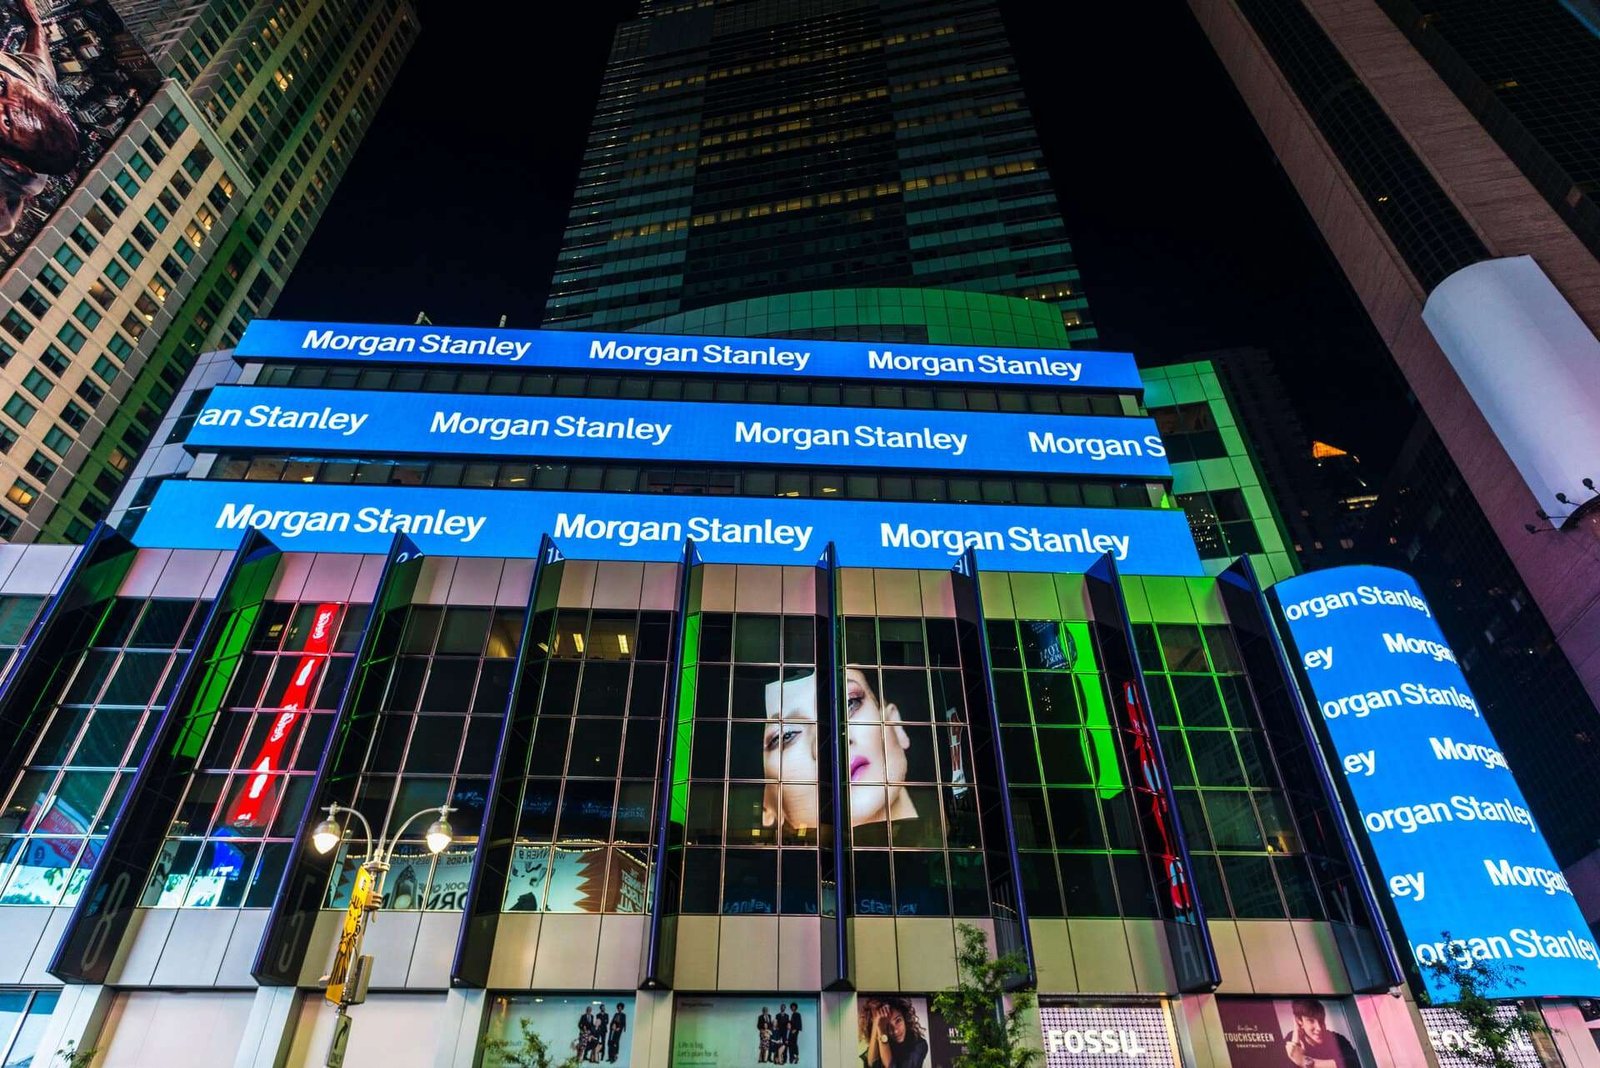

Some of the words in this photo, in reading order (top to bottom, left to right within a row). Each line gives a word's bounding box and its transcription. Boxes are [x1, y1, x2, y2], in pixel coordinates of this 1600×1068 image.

[301, 329, 416, 356] Morgan
[418, 334, 532, 361] Stanley
[589, 340, 699, 366] Morgan
[702, 344, 811, 371] Stanley
[868, 350, 975, 376] Morgan
[977, 354, 1082, 382] Stanley
[244, 404, 369, 436] Stanley
[429, 411, 550, 441] Morgan
[553, 415, 672, 446] Stanley
[735, 421, 850, 451] Morgan
[854, 425, 968, 456] Stanley
[1028, 431, 1143, 461] Morgan
[215, 503, 351, 538] Morgan
[353, 507, 487, 543] Stanley
[553, 512, 682, 547] Morgan
[686, 517, 813, 552] Stanley
[880, 522, 1005, 556] Morgan
[1008, 526, 1130, 561] Stanley
[1282, 590, 1359, 622] organ
[1356, 585, 1431, 618] Stanley
[1304, 646, 1333, 670] ey
[1319, 688, 1403, 720] organ
[1400, 682, 1480, 718] Stanley
[1343, 750, 1376, 777] ey
[1360, 802, 1453, 834] organ
[1450, 795, 1536, 833] Stanley
[1390, 871, 1425, 902] ey
[1408, 936, 1514, 970] organ
[1509, 928, 1600, 969] Stanley
[1047, 1028, 1146, 1058] FOSSIL
[1224, 1032, 1275, 1042] TOUCHSCREEN
[1428, 1026, 1535, 1054] FOSL
